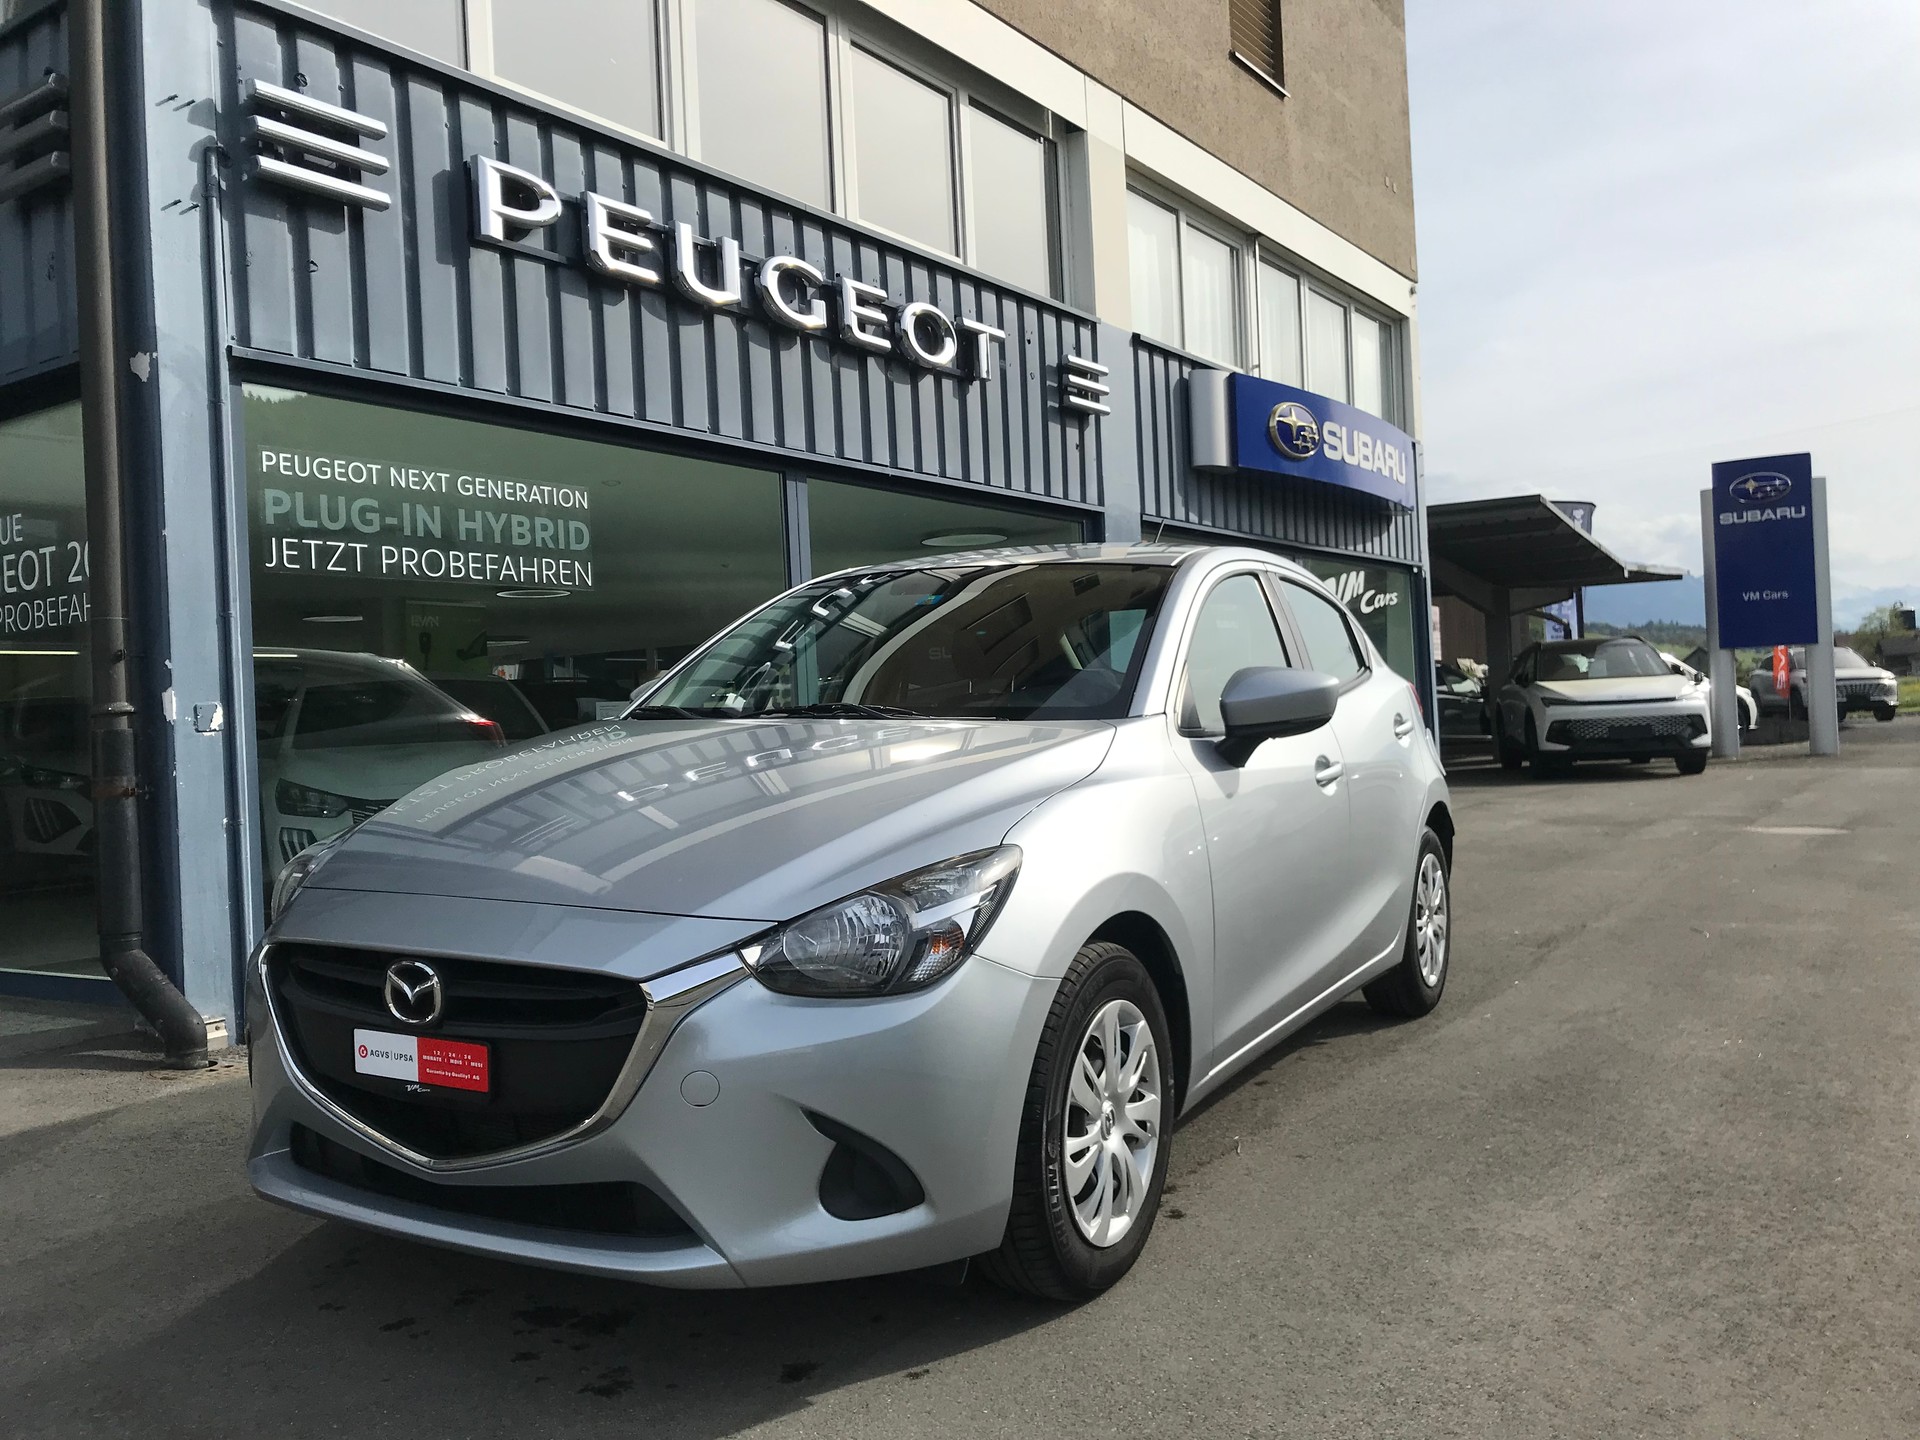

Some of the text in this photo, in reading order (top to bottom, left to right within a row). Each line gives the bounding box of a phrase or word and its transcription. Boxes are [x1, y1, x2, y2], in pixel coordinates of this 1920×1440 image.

[470, 154, 1006, 382] PEUGEOT
[1322, 421, 1407, 485] SUBARU
[261, 450, 588, 510] PEUGEOT NEXT GENERATION
[264, 488, 590, 551] PLUG-IN HYBRID
[1719, 505, 1806, 525] SUBARU
[264, 537, 593, 587] JETZT PROBEFAHREN
[0, 592, 91, 633] ROBEFAH
[1360, 589, 1399, 614] Cars
[1742, 589, 1789, 602] VM Cars
[369, 1049, 390, 1059] AGVS
[393, 1052, 414, 1063] UPSA
